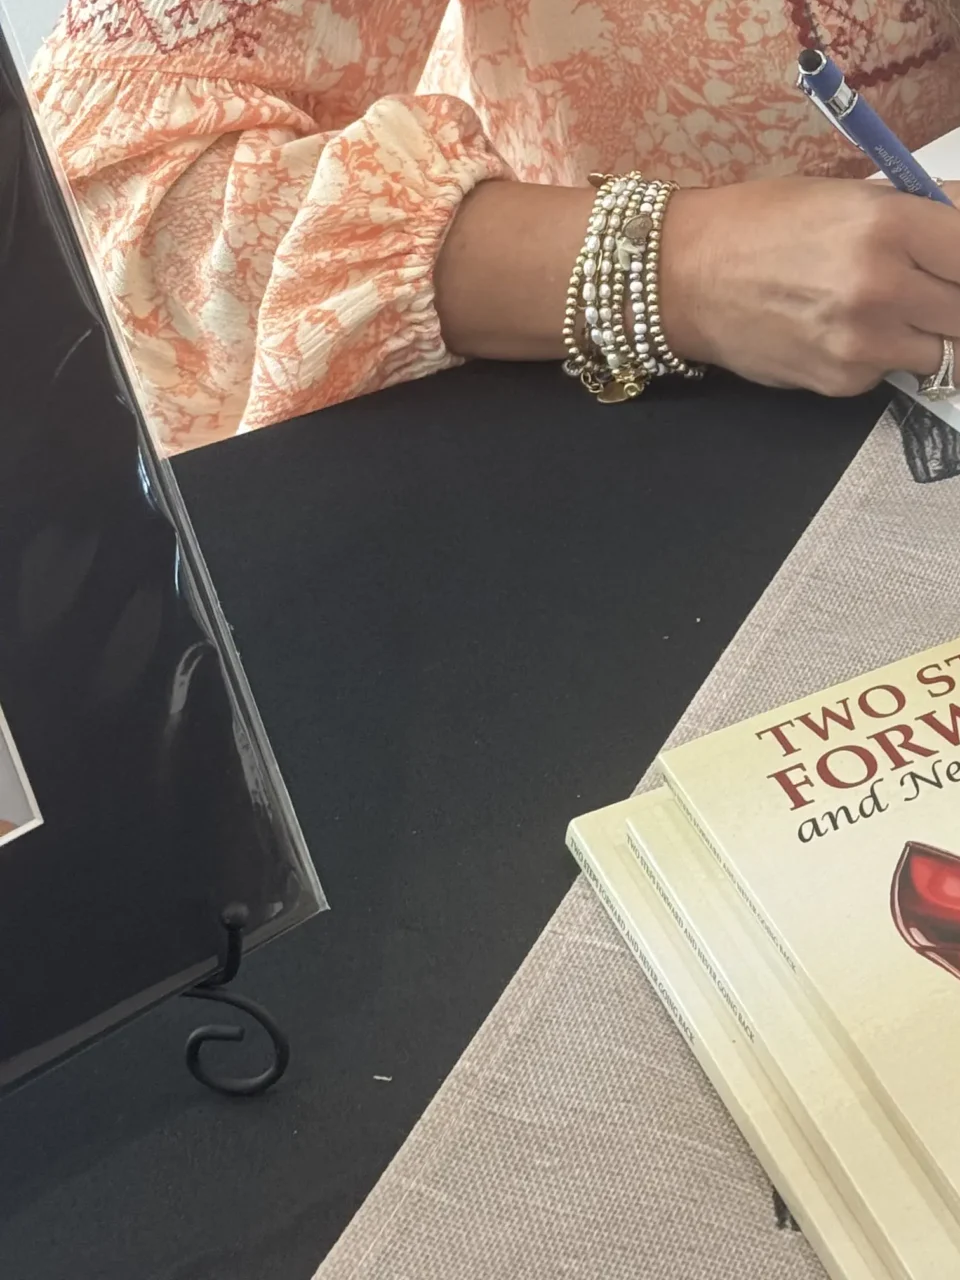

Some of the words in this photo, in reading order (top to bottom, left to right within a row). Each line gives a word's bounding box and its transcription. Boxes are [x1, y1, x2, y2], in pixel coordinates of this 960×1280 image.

[875, 145, 895, 167] Spine
[755, 683, 906, 757] TWO
[796, 777, 889, 843] and
[569, 837, 584, 863] TWO
[583, 861, 599, 888] STEPS
[598, 883, 626, 931] FORWARD
[624, 930, 640, 953] AND
[638, 950, 659, 987] NEVER
[658, 982, 679, 1018] GOING
[677, 1016, 695, 1045] BACK
[626, 833, 640, 859] TWO
[639, 856, 656, 885] STEPS
[655, 880, 684, 929] FORWARD
[683, 927, 698, 951] AND
[697, 948, 717, 986] NEVER
[716, 979, 738, 1017] GOING
[737, 1012, 755, 1043] BACK
[736, 881, 757, 915] NEVER
[757, 912, 779, 948] GOING
[779, 945, 796, 973] BACK
